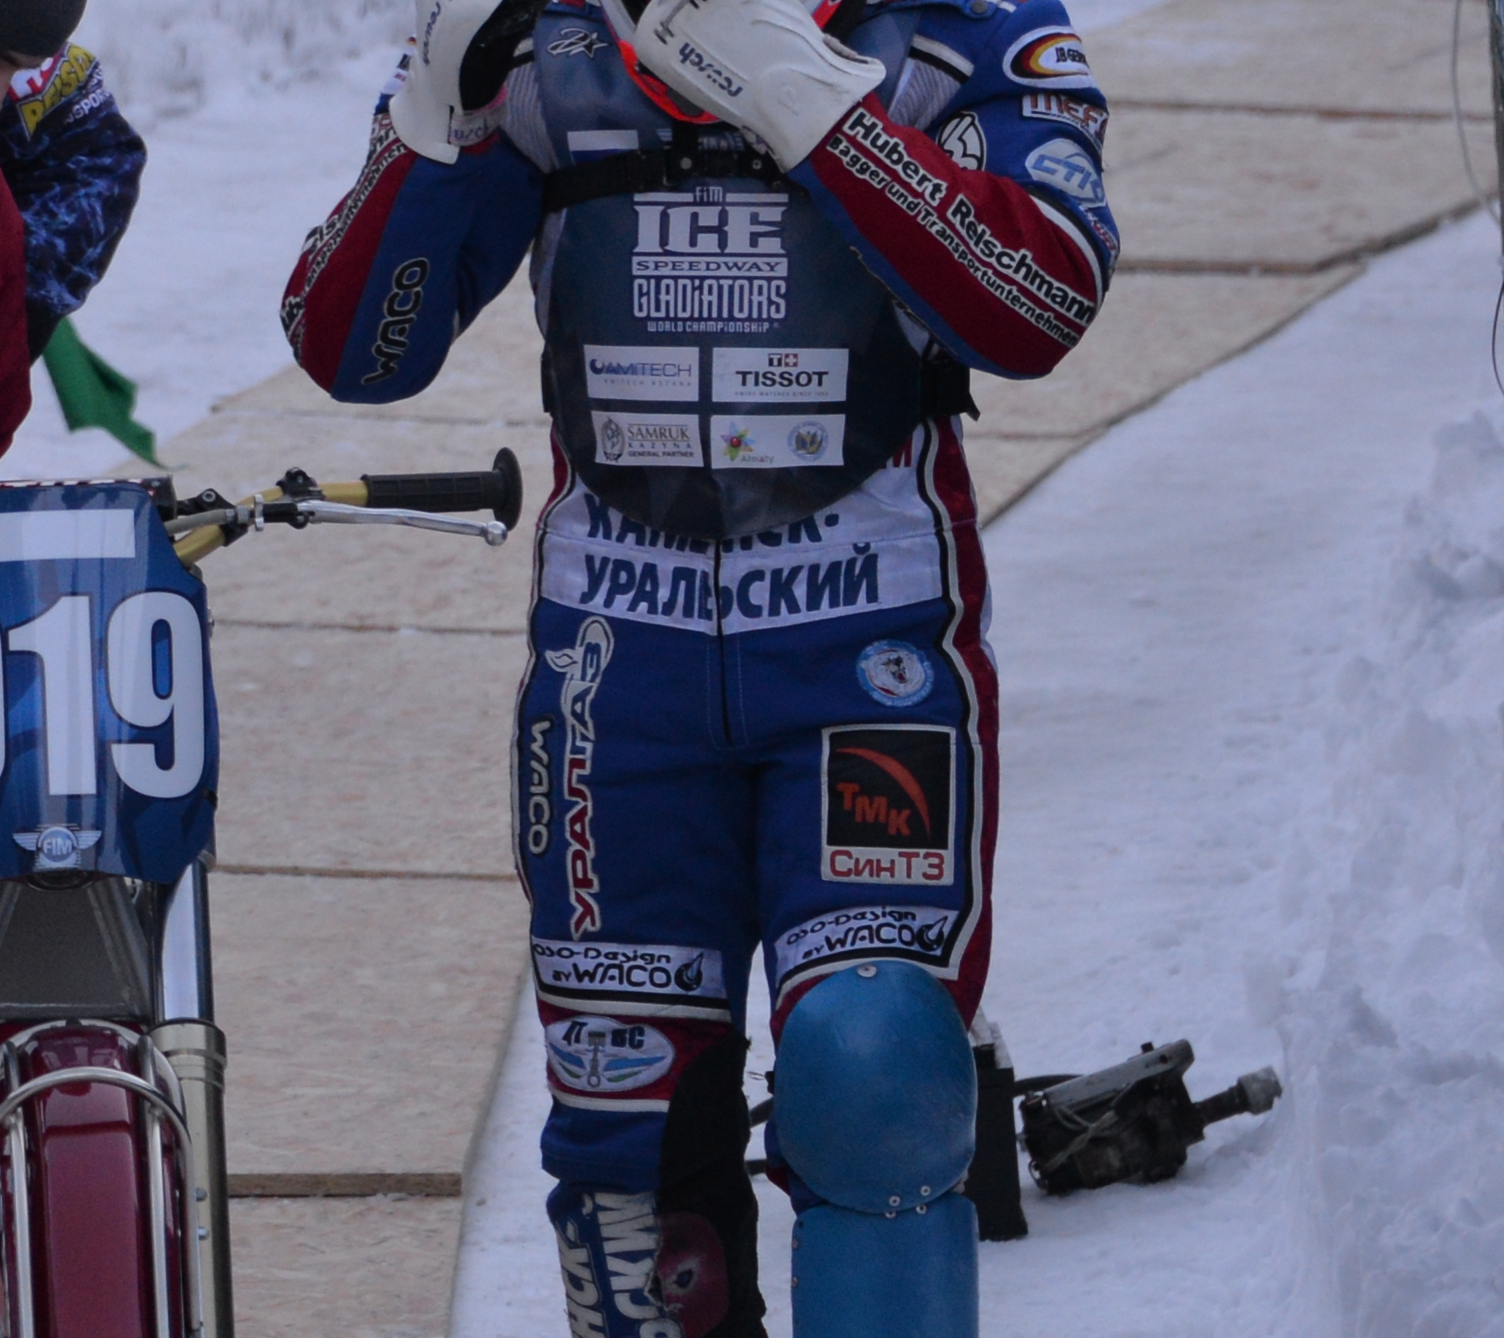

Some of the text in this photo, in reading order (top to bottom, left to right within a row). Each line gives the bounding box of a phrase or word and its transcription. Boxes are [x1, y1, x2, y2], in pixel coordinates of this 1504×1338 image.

[846, 111, 946, 203] Hubert
[632, 205, 788, 254] ICE
[828, 136, 888, 185] Bagger
[887, 182, 918, 214] und
[918, 208, 1080, 347] Transportunternehmen
[635, 260, 781, 273] SPEEDWAY
[361, 256, 430, 386] WACO
[647, 321, 683, 332] WORLD
[605, 362, 692, 377] AMITECH
[735, 370, 829, 387] TISSOT
[627, 426, 689, 440] SAMRUK
[580, 541, 879, 621] УРАЛЬСКИЙ
[529, 719, 553, 855] WACO
[43, 837, 73, 855] FIM
[829, 849, 945, 881] СинТЗ
[825, 922, 916, 952] WACO
[572, 962, 672, 988] WACO
